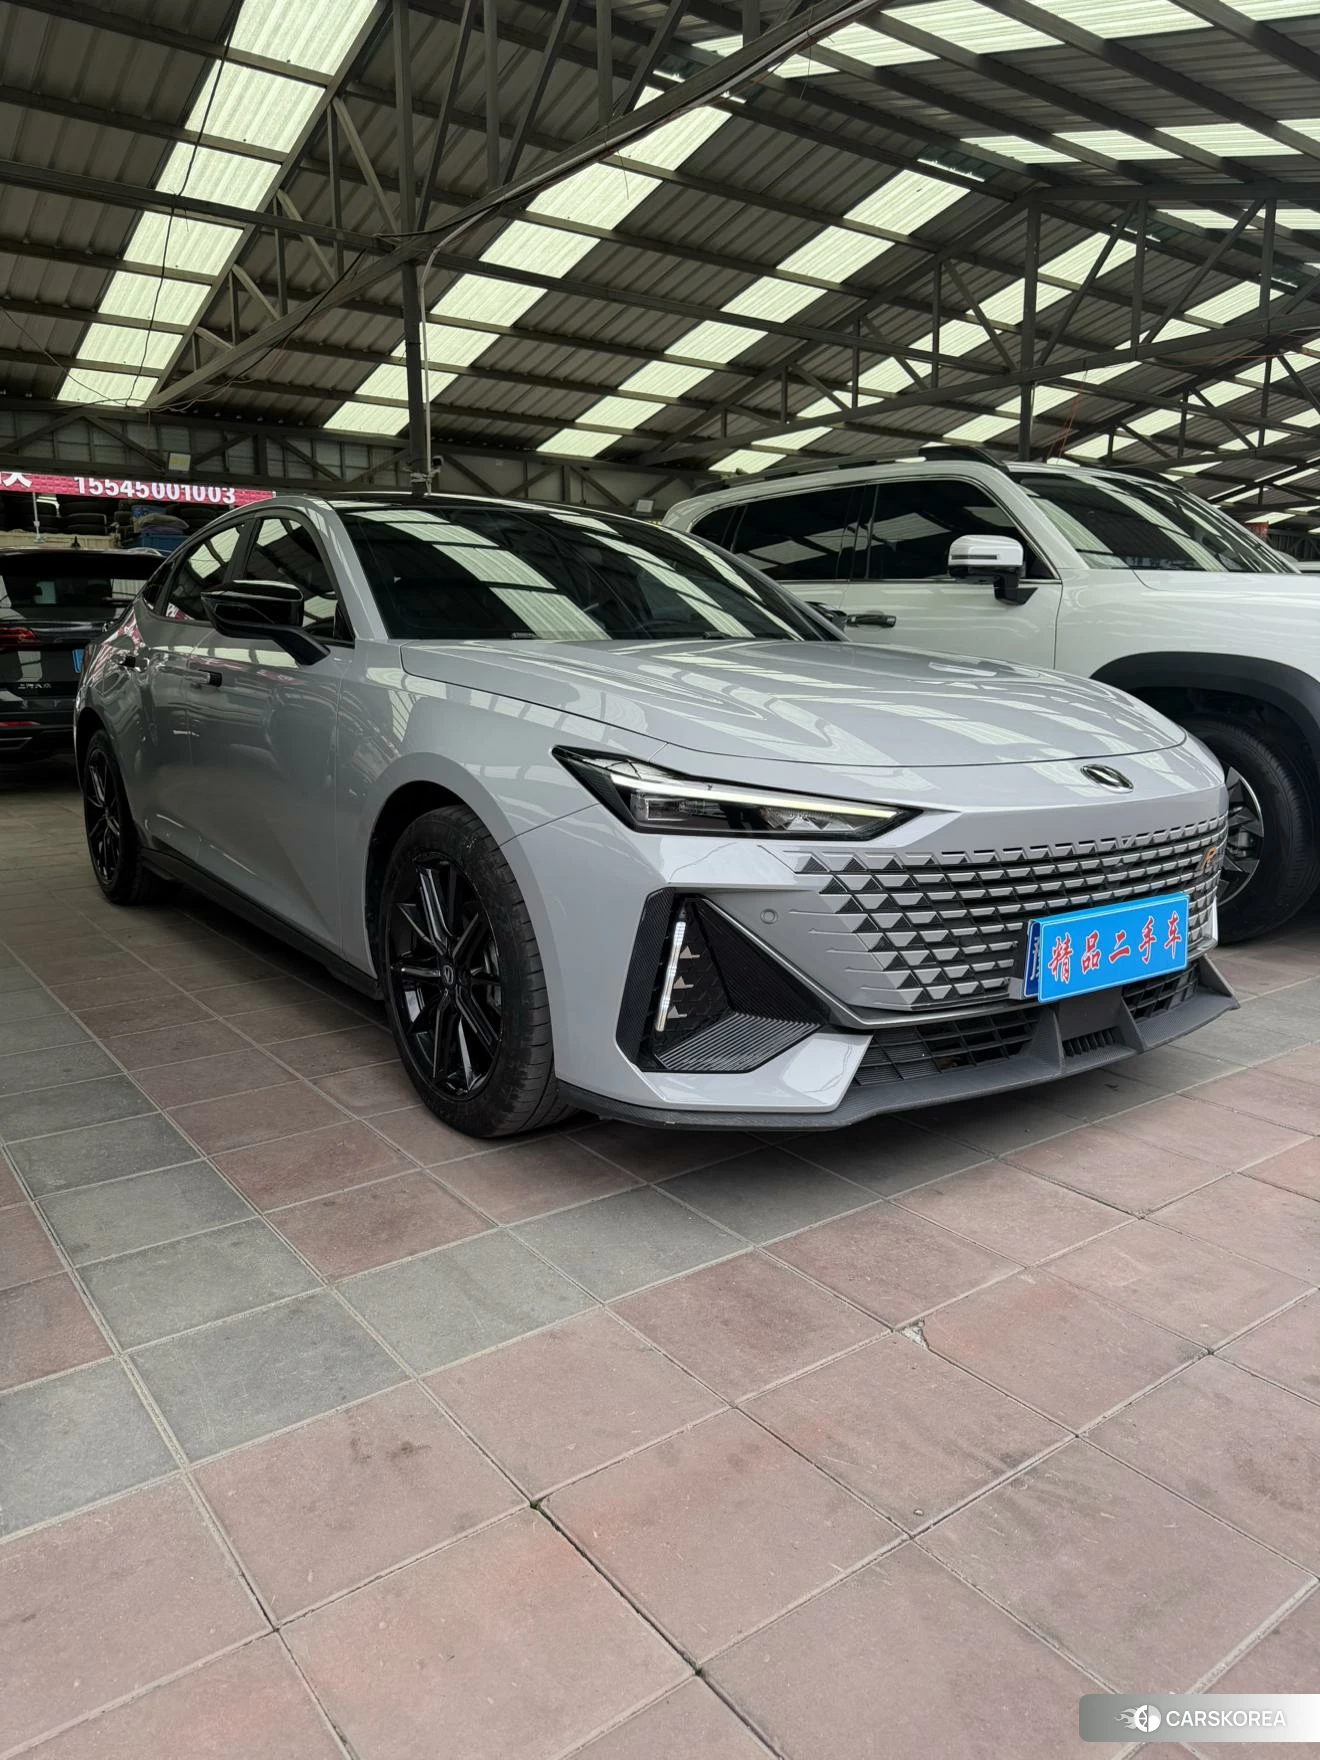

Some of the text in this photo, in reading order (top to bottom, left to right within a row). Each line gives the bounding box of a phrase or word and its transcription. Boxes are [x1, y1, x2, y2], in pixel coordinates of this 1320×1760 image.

[74, 477, 236, 504] 15545001003
[1048, 911, 1182, 984] 精品二手车
